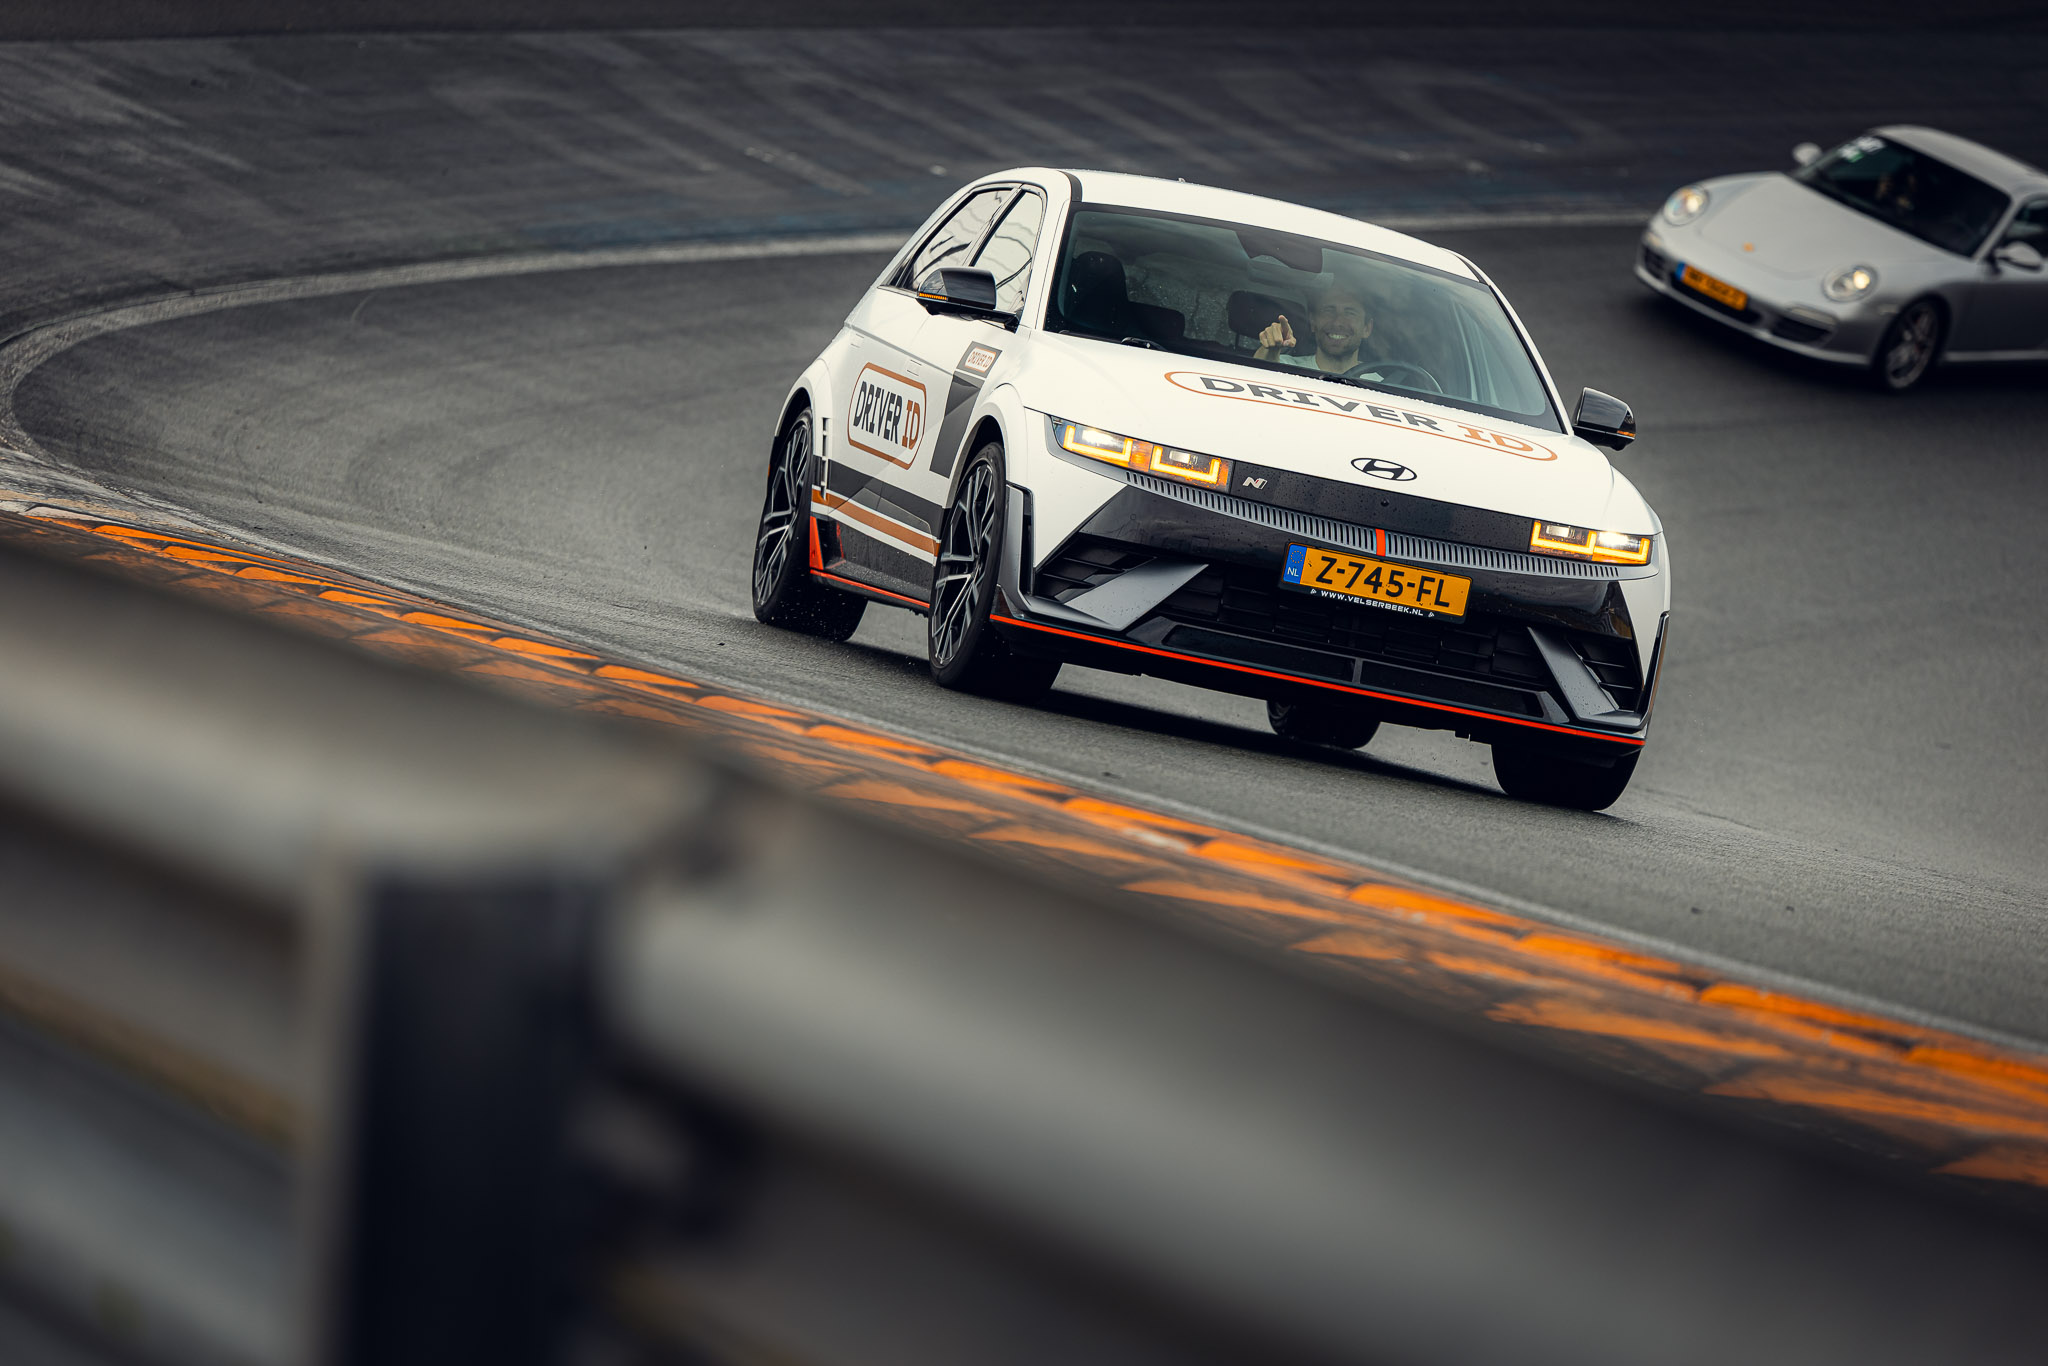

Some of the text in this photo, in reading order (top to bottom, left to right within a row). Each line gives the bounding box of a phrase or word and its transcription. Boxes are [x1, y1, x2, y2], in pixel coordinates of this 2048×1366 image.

[853, 381, 921, 450] DRIVER ID
[1199, 376, 1534, 452] DRIVER ID
[1287, 566, 1299, 577] NL
[1316, 555, 1450, 608] Z-745-FL
[1321, 590, 1424, 616] WWW.VELSERBEEK.NL
